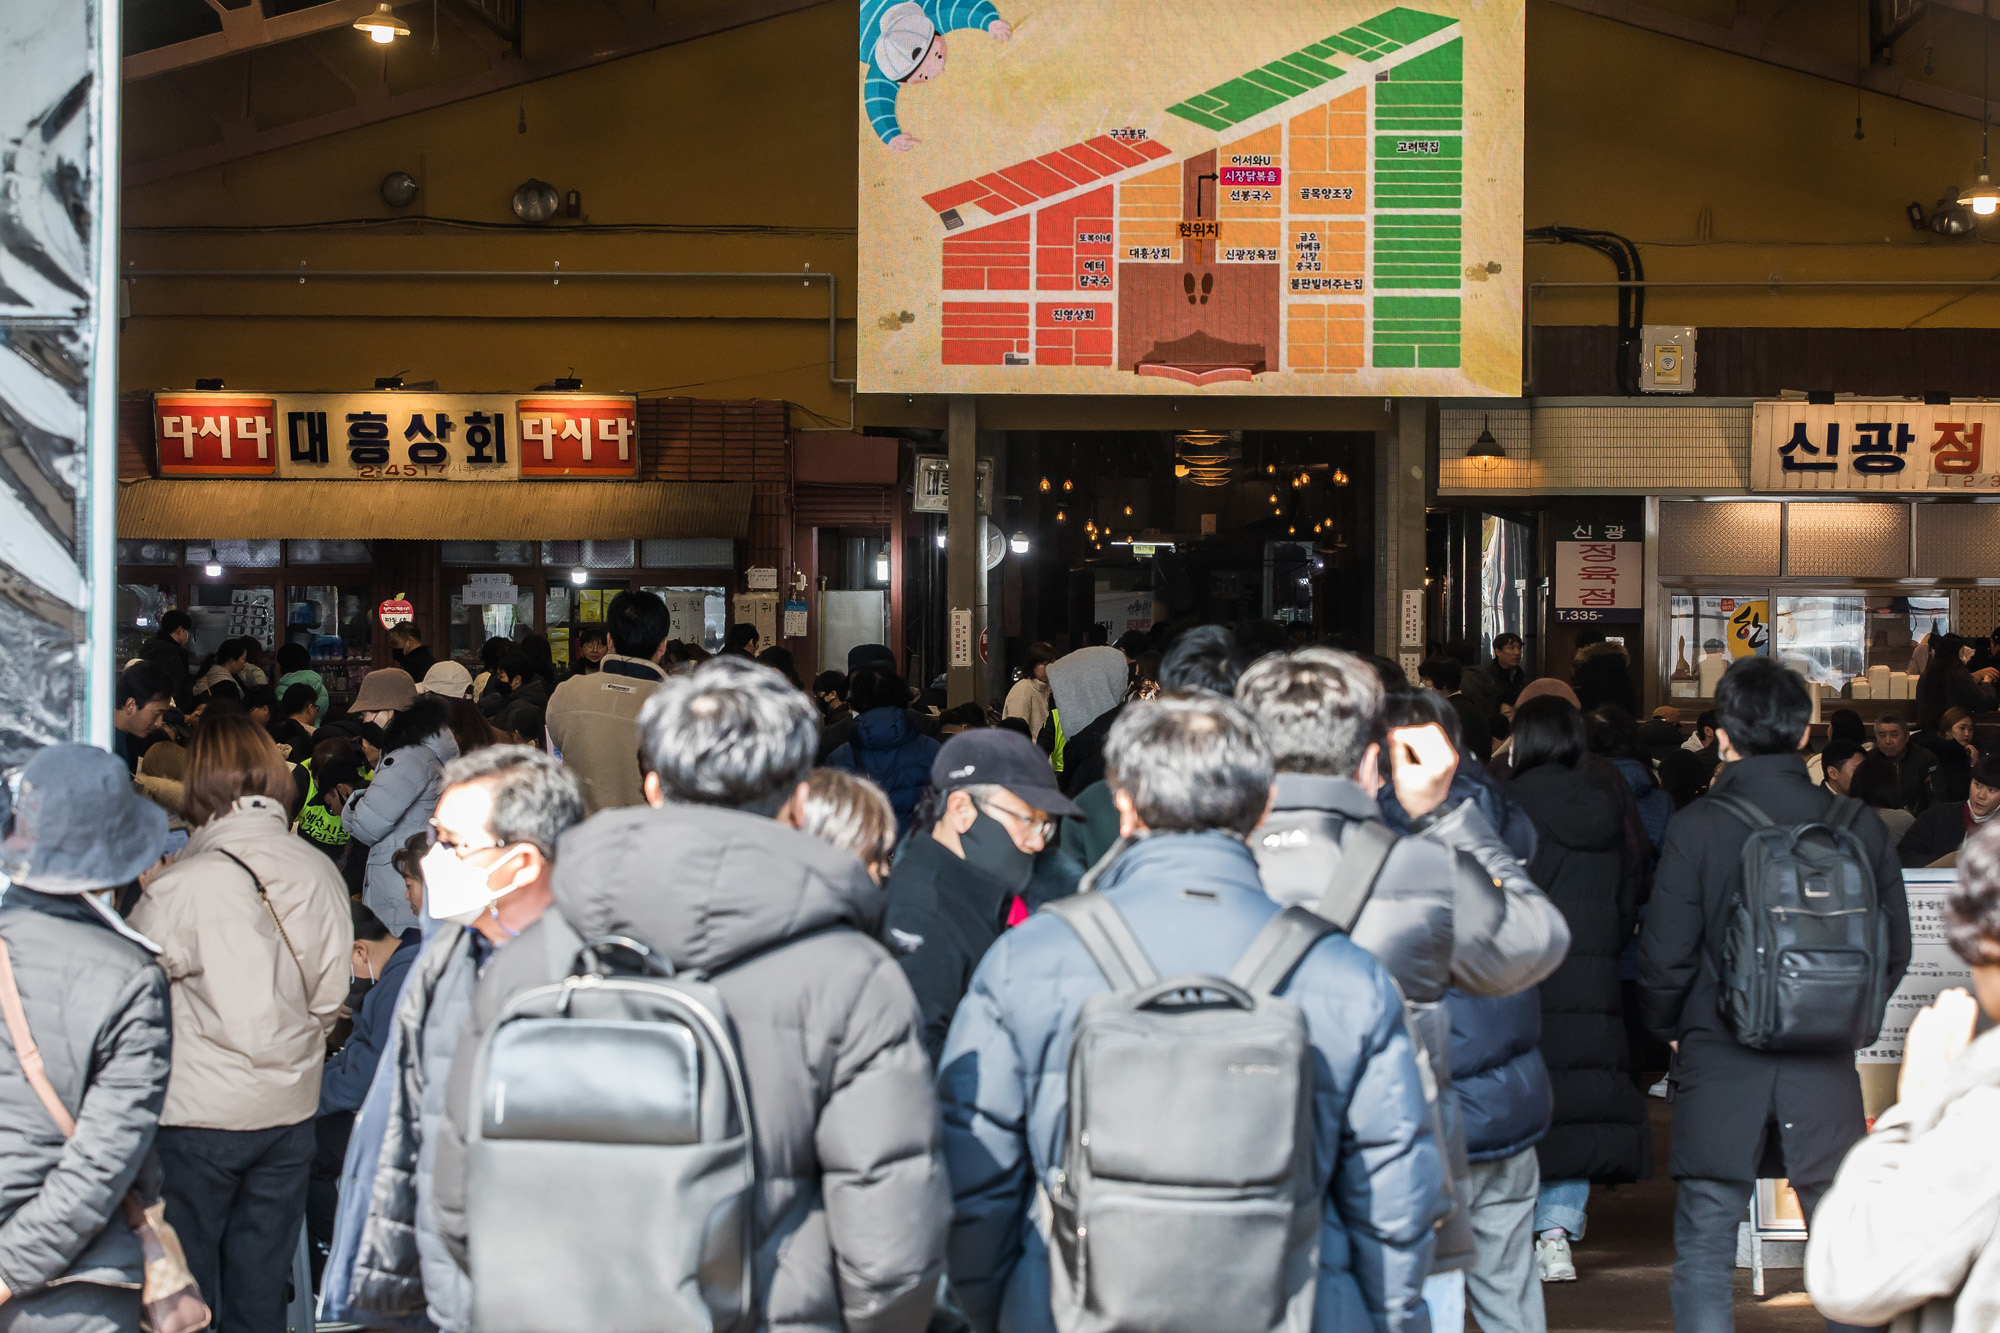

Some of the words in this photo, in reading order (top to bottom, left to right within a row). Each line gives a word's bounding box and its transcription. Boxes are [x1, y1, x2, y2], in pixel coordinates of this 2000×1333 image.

[1110, 129, 1146, 139] 구구통닭
[1397, 141, 1439, 153] 고려떡집
[1232, 156, 1271, 166] 어서와U
[1224, 171, 1277, 182] 시장닭볶음
[1230, 190, 1272, 201] 선봉국수
[1300, 188, 1353, 199] 골목양조장
[1179, 223, 1218, 238] 현위치
[1079, 233, 1111, 243] 또복이네
[1300, 233, 1317, 241] 금오
[1296, 243, 1321, 252] 바베큐
[1130, 248, 1170, 259] 대흥상회
[1225, 250, 1277, 261] 신광정육점
[1300, 252, 1317, 261] 시장
[1296, 262, 1321, 271] 중국집
[1079, 275, 1110, 287] 칼국수
[1291, 278, 1363, 290] 불판빌려주는집
[1053, 309, 1094, 321] 진영상회
[162, 415, 272, 459] 다시다
[288, 411, 506, 463] 대흥상회
[521, 417, 634, 461] 다시다
[1572, 524, 1626, 539] 신광
[1577, 543, 1620, 606] 정육점
[1557, 610, 1603, 621] T.335-
